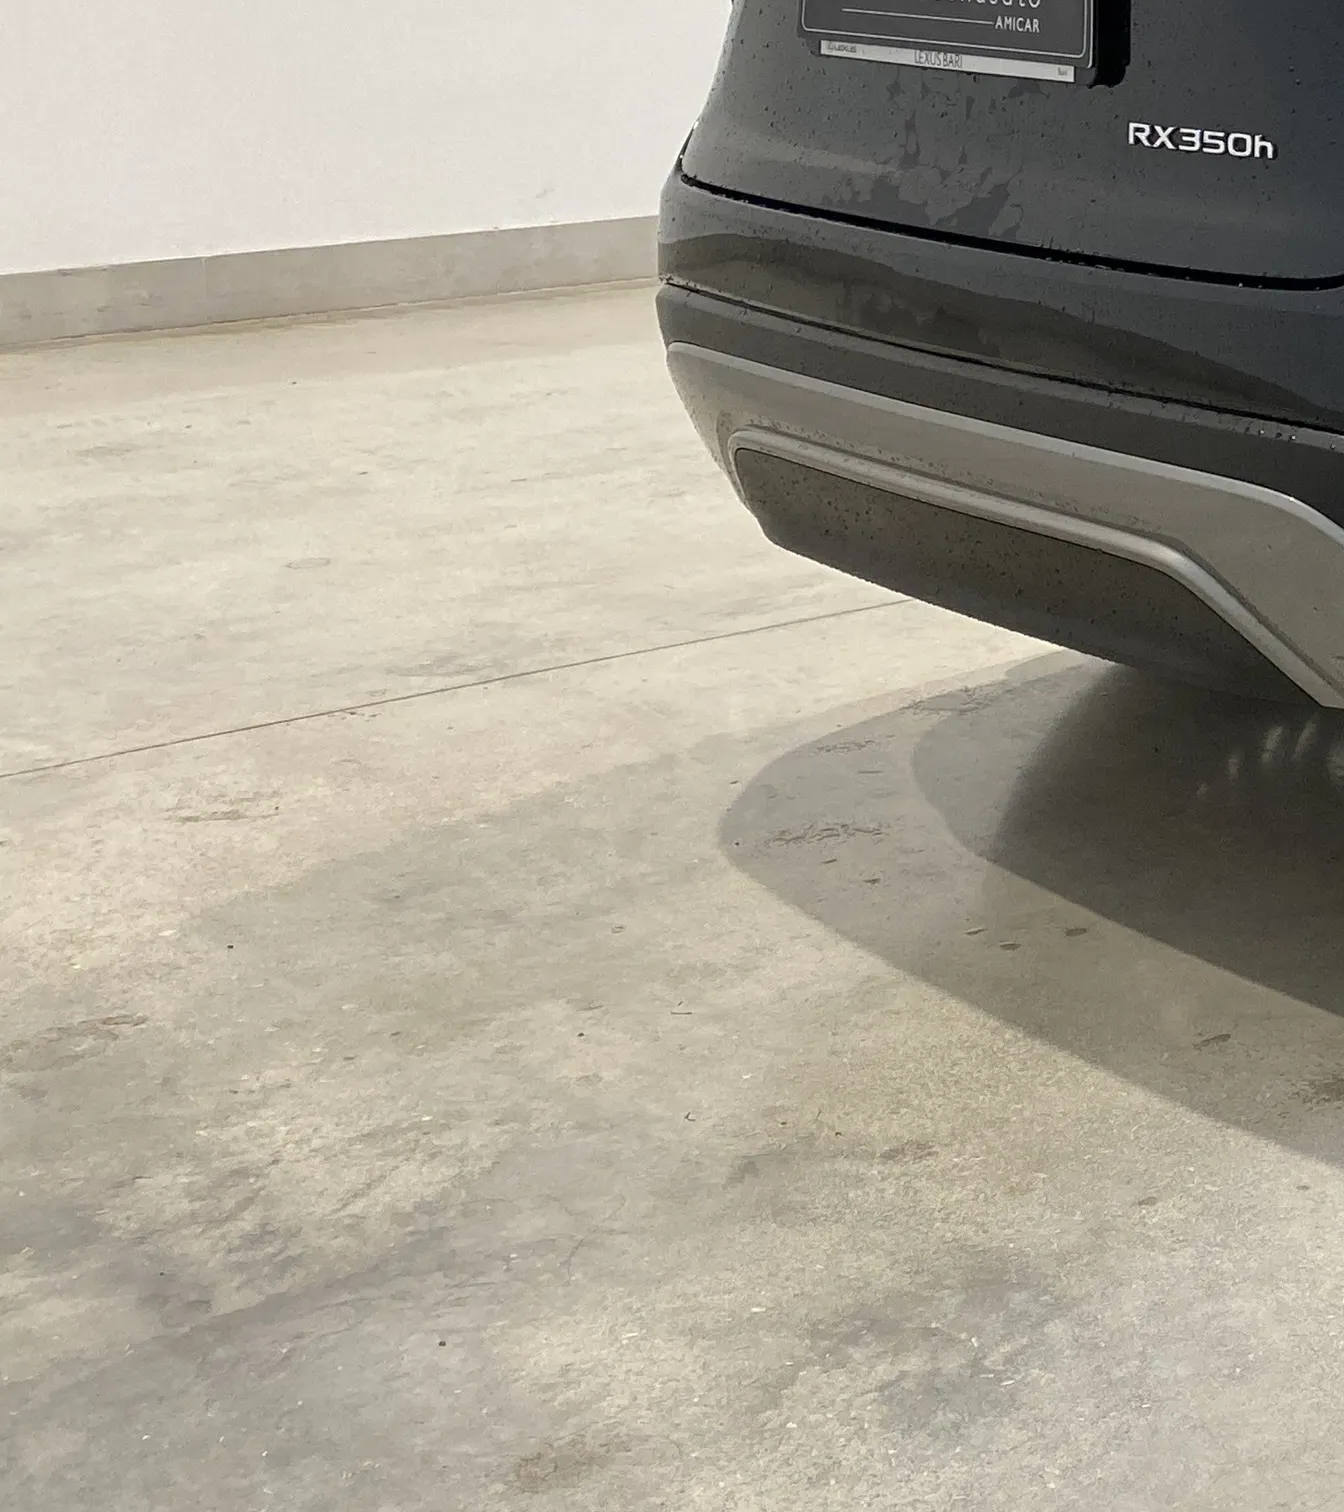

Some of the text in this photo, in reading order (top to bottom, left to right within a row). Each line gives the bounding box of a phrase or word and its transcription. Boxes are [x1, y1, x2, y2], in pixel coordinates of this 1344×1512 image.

[994, 15, 1040, 34] AMICAR
[914, 50, 963, 69] LEXUS BARI
[1128, 122, 1274, 159] RX350h
